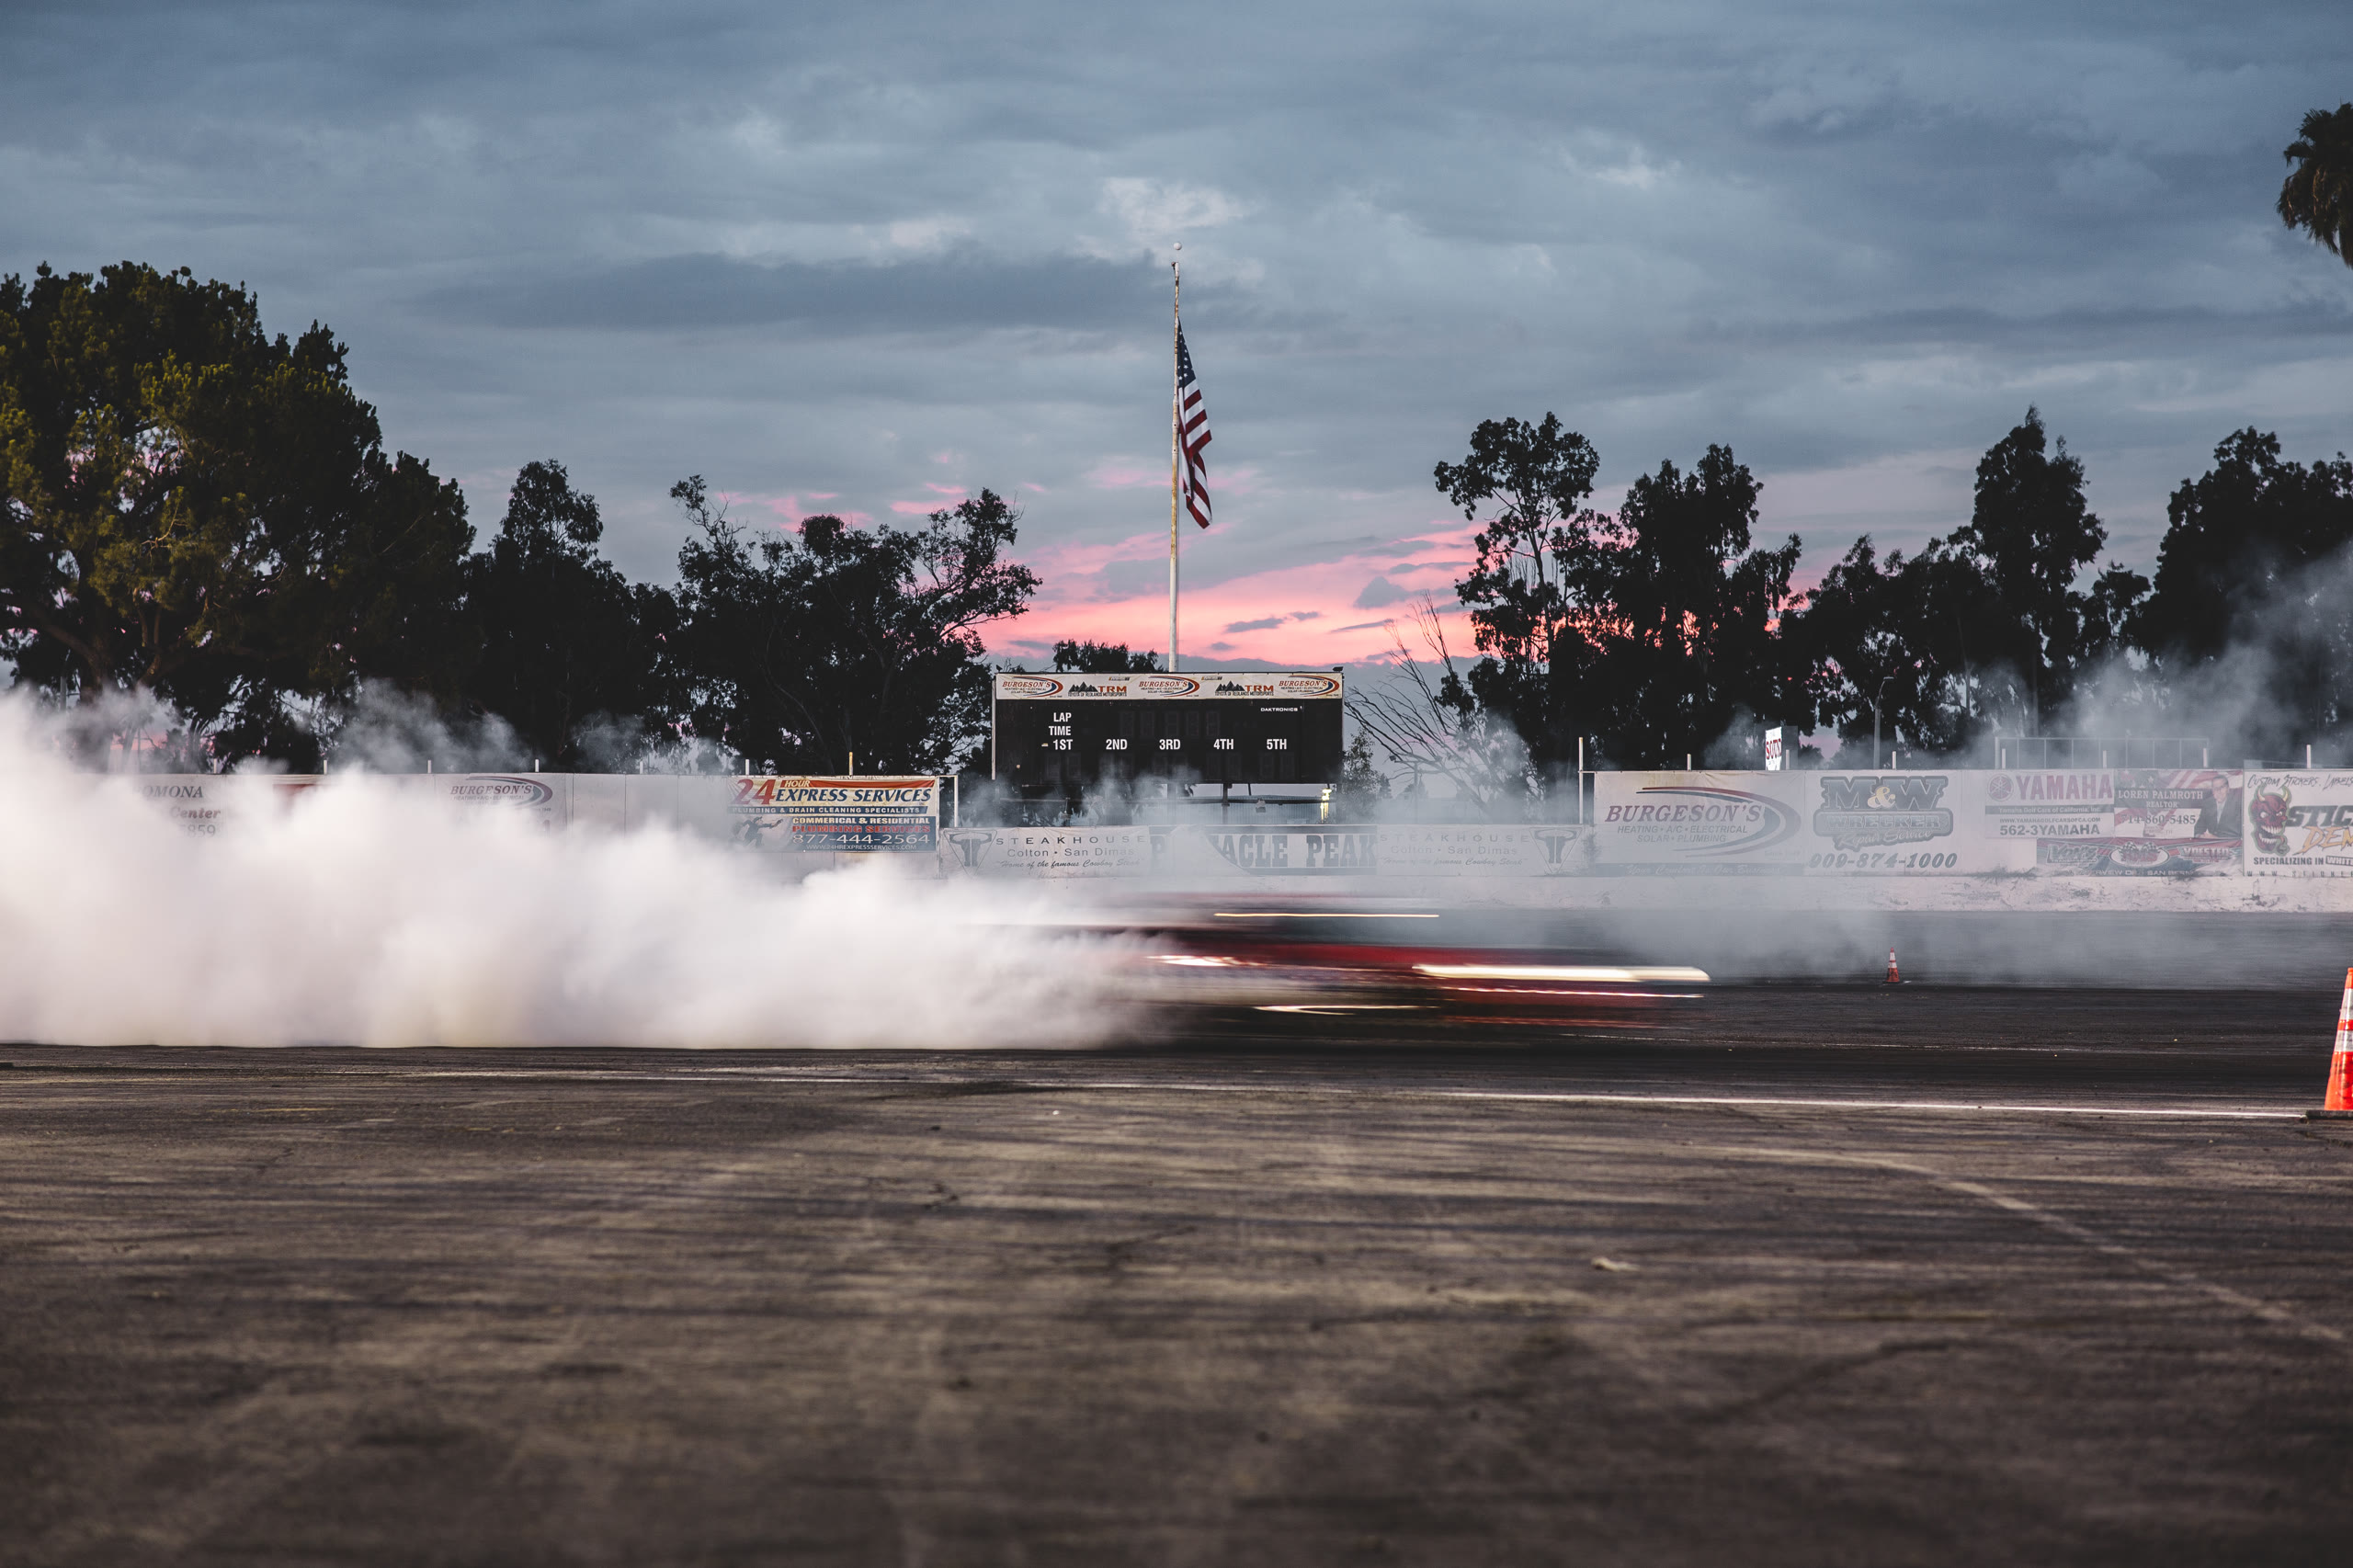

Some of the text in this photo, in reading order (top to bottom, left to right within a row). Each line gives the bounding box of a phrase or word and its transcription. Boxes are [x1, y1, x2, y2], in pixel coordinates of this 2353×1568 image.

[1053, 712, 1072, 722] LAP
[1049, 725, 1072, 736] TIME
[1052, 739, 1074, 750] 1ST
[1106, 739, 1128, 750] 2ND
[1159, 739, 1181, 750] 3RD
[1213, 738, 1234, 750] 4TH
[1267, 738, 1288, 750] 5TH
[784, 779, 811, 788] HOUR
[2016, 774, 2113, 800] YAMAHA
[734, 778, 776, 805] 24
[776, 789, 931, 801] EXPRESS SERVICES
[2118, 790, 2203, 800] LOREN PALMROTH
[1605, 805, 1762, 823] BURGESON'S
[2120, 814, 2196, 824] 714-860-5485
[1826, 815, 1940, 827] WRECKER
[1618, 825, 1748, 834] HEATING A/C ELECTRICAL
[2000, 824, 2100, 835] 562-3YAMAHA
[792, 834, 930, 844] 877-444-2564
[995, 835, 1146, 846] STEAKHOUSE
[1380, 834, 1529, 843] STEAKHOUSE
[1637, 835, 1726, 843] SOLAR PLUMBING
[1007, 847, 1135, 858] Colton San Dimas
[1448, 846, 1471, 855] San
[1478, 846, 1517, 855] Dimas
[1051, 861, 1080, 869] famous
[1082, 859, 1113, 868] Cowboy
[1465, 858, 1496, 866] Cowboy
[1809, 853, 1958, 869] 909-874-1000
[2254, 857, 2312, 865] SPECIALIZING
